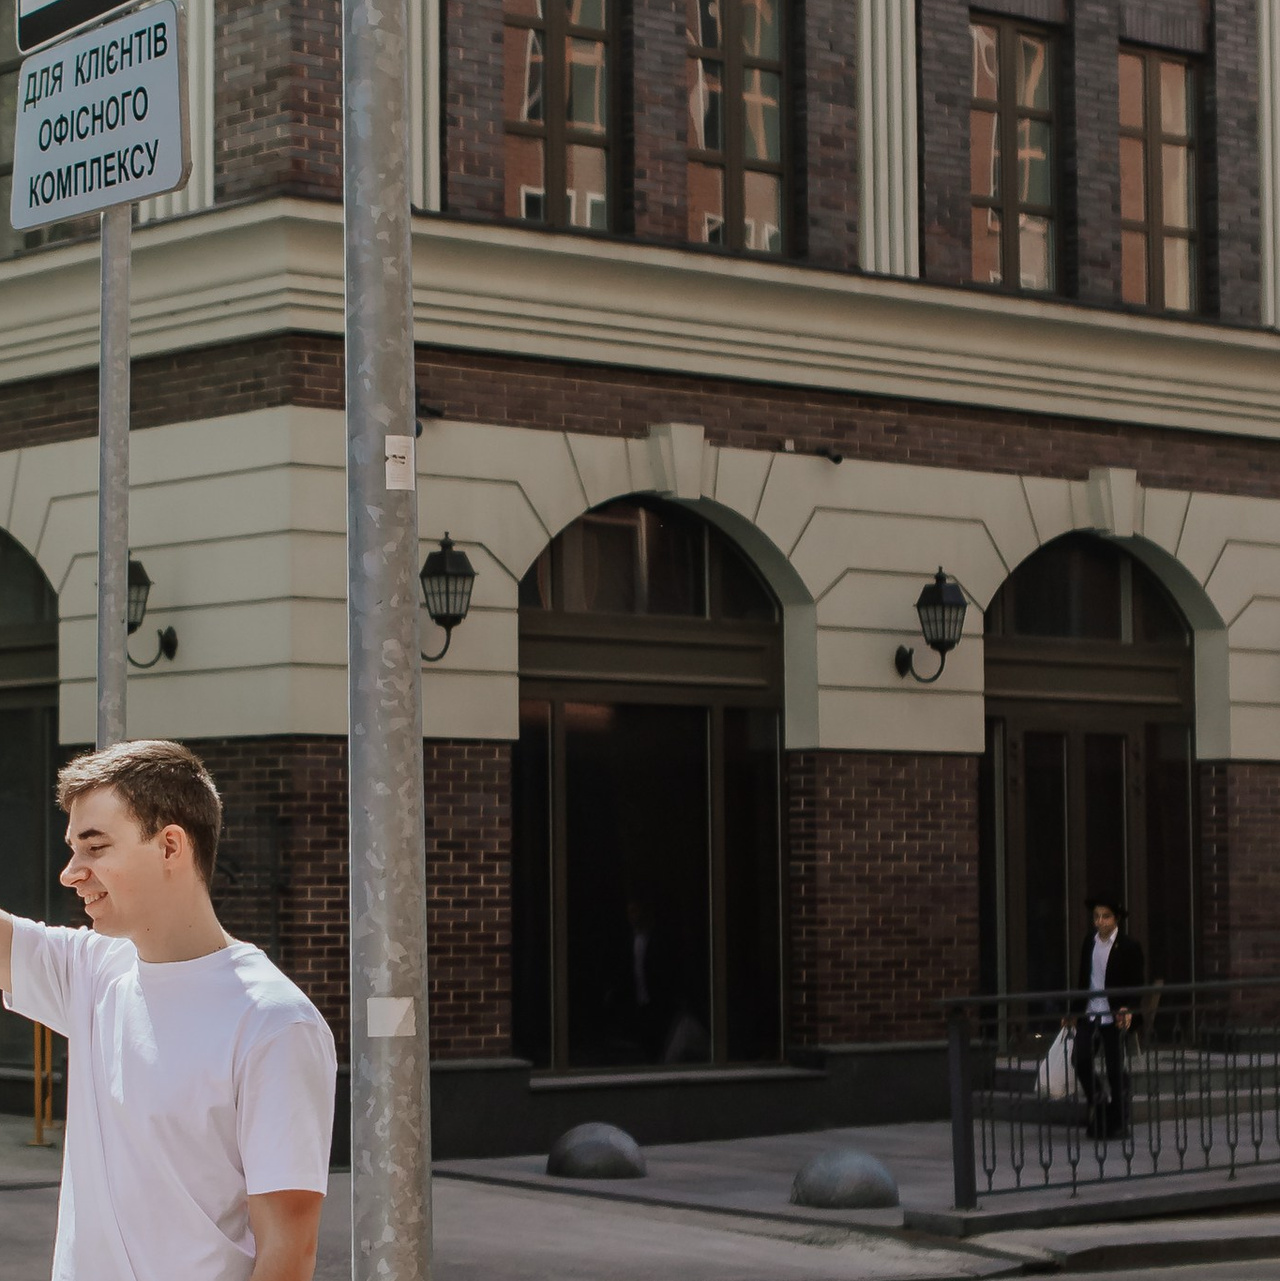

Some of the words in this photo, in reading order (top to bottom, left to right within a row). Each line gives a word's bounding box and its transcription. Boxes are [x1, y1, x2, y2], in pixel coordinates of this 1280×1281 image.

[23, 60, 64, 113] ДЛЯ
[74, 21, 168, 87] КЛІЄНТІВ
[38, 85, 149, 152] ОФІСНОГО
[28, 138, 160, 209] КОМПЛЕКСУ
